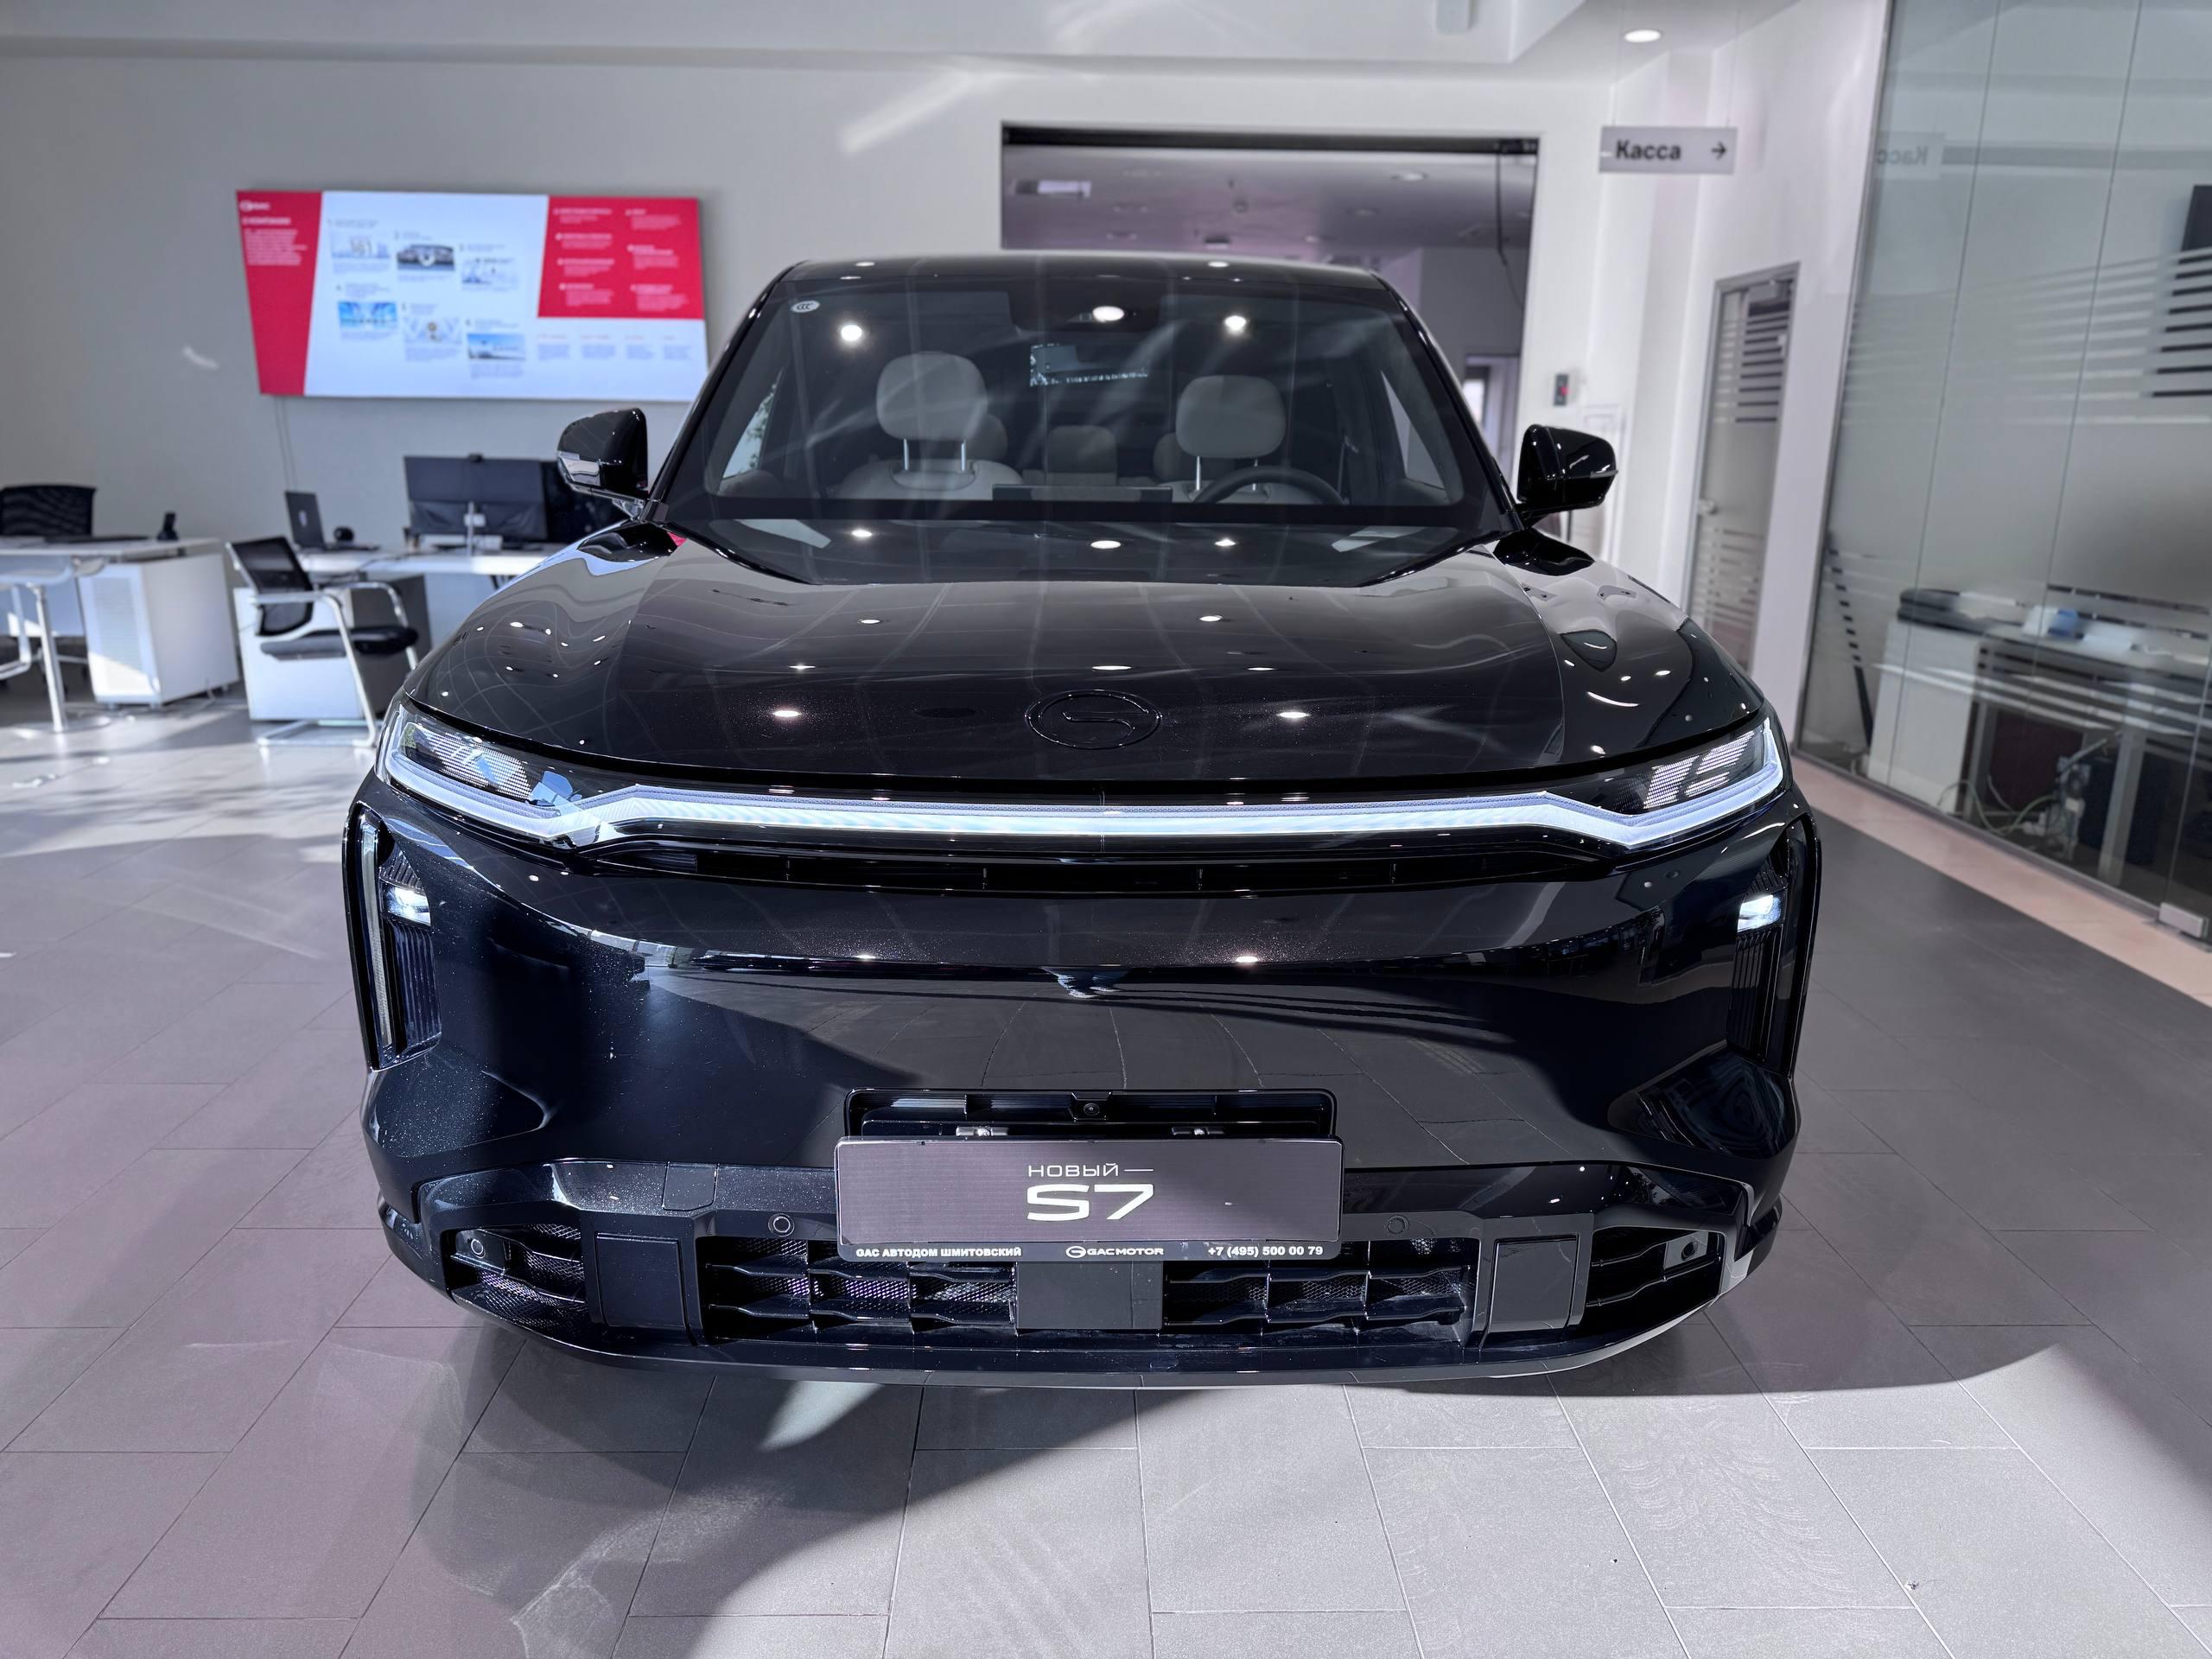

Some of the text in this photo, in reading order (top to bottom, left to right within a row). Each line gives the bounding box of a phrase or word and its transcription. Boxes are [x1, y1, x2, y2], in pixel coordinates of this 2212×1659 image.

[1616, 140, 1682, 162] Касса
[1028, 1163, 1119, 1177] НОВЫЙ
[1027, 1184, 1154, 1221] S7
[882, 1248, 938, 1258] АВТОДОМ
[940, 1247, 1022, 1257] ШМИТОВСКИЙ
[1208, 1246, 1324, 1257] +7 (495) 500 00 79
